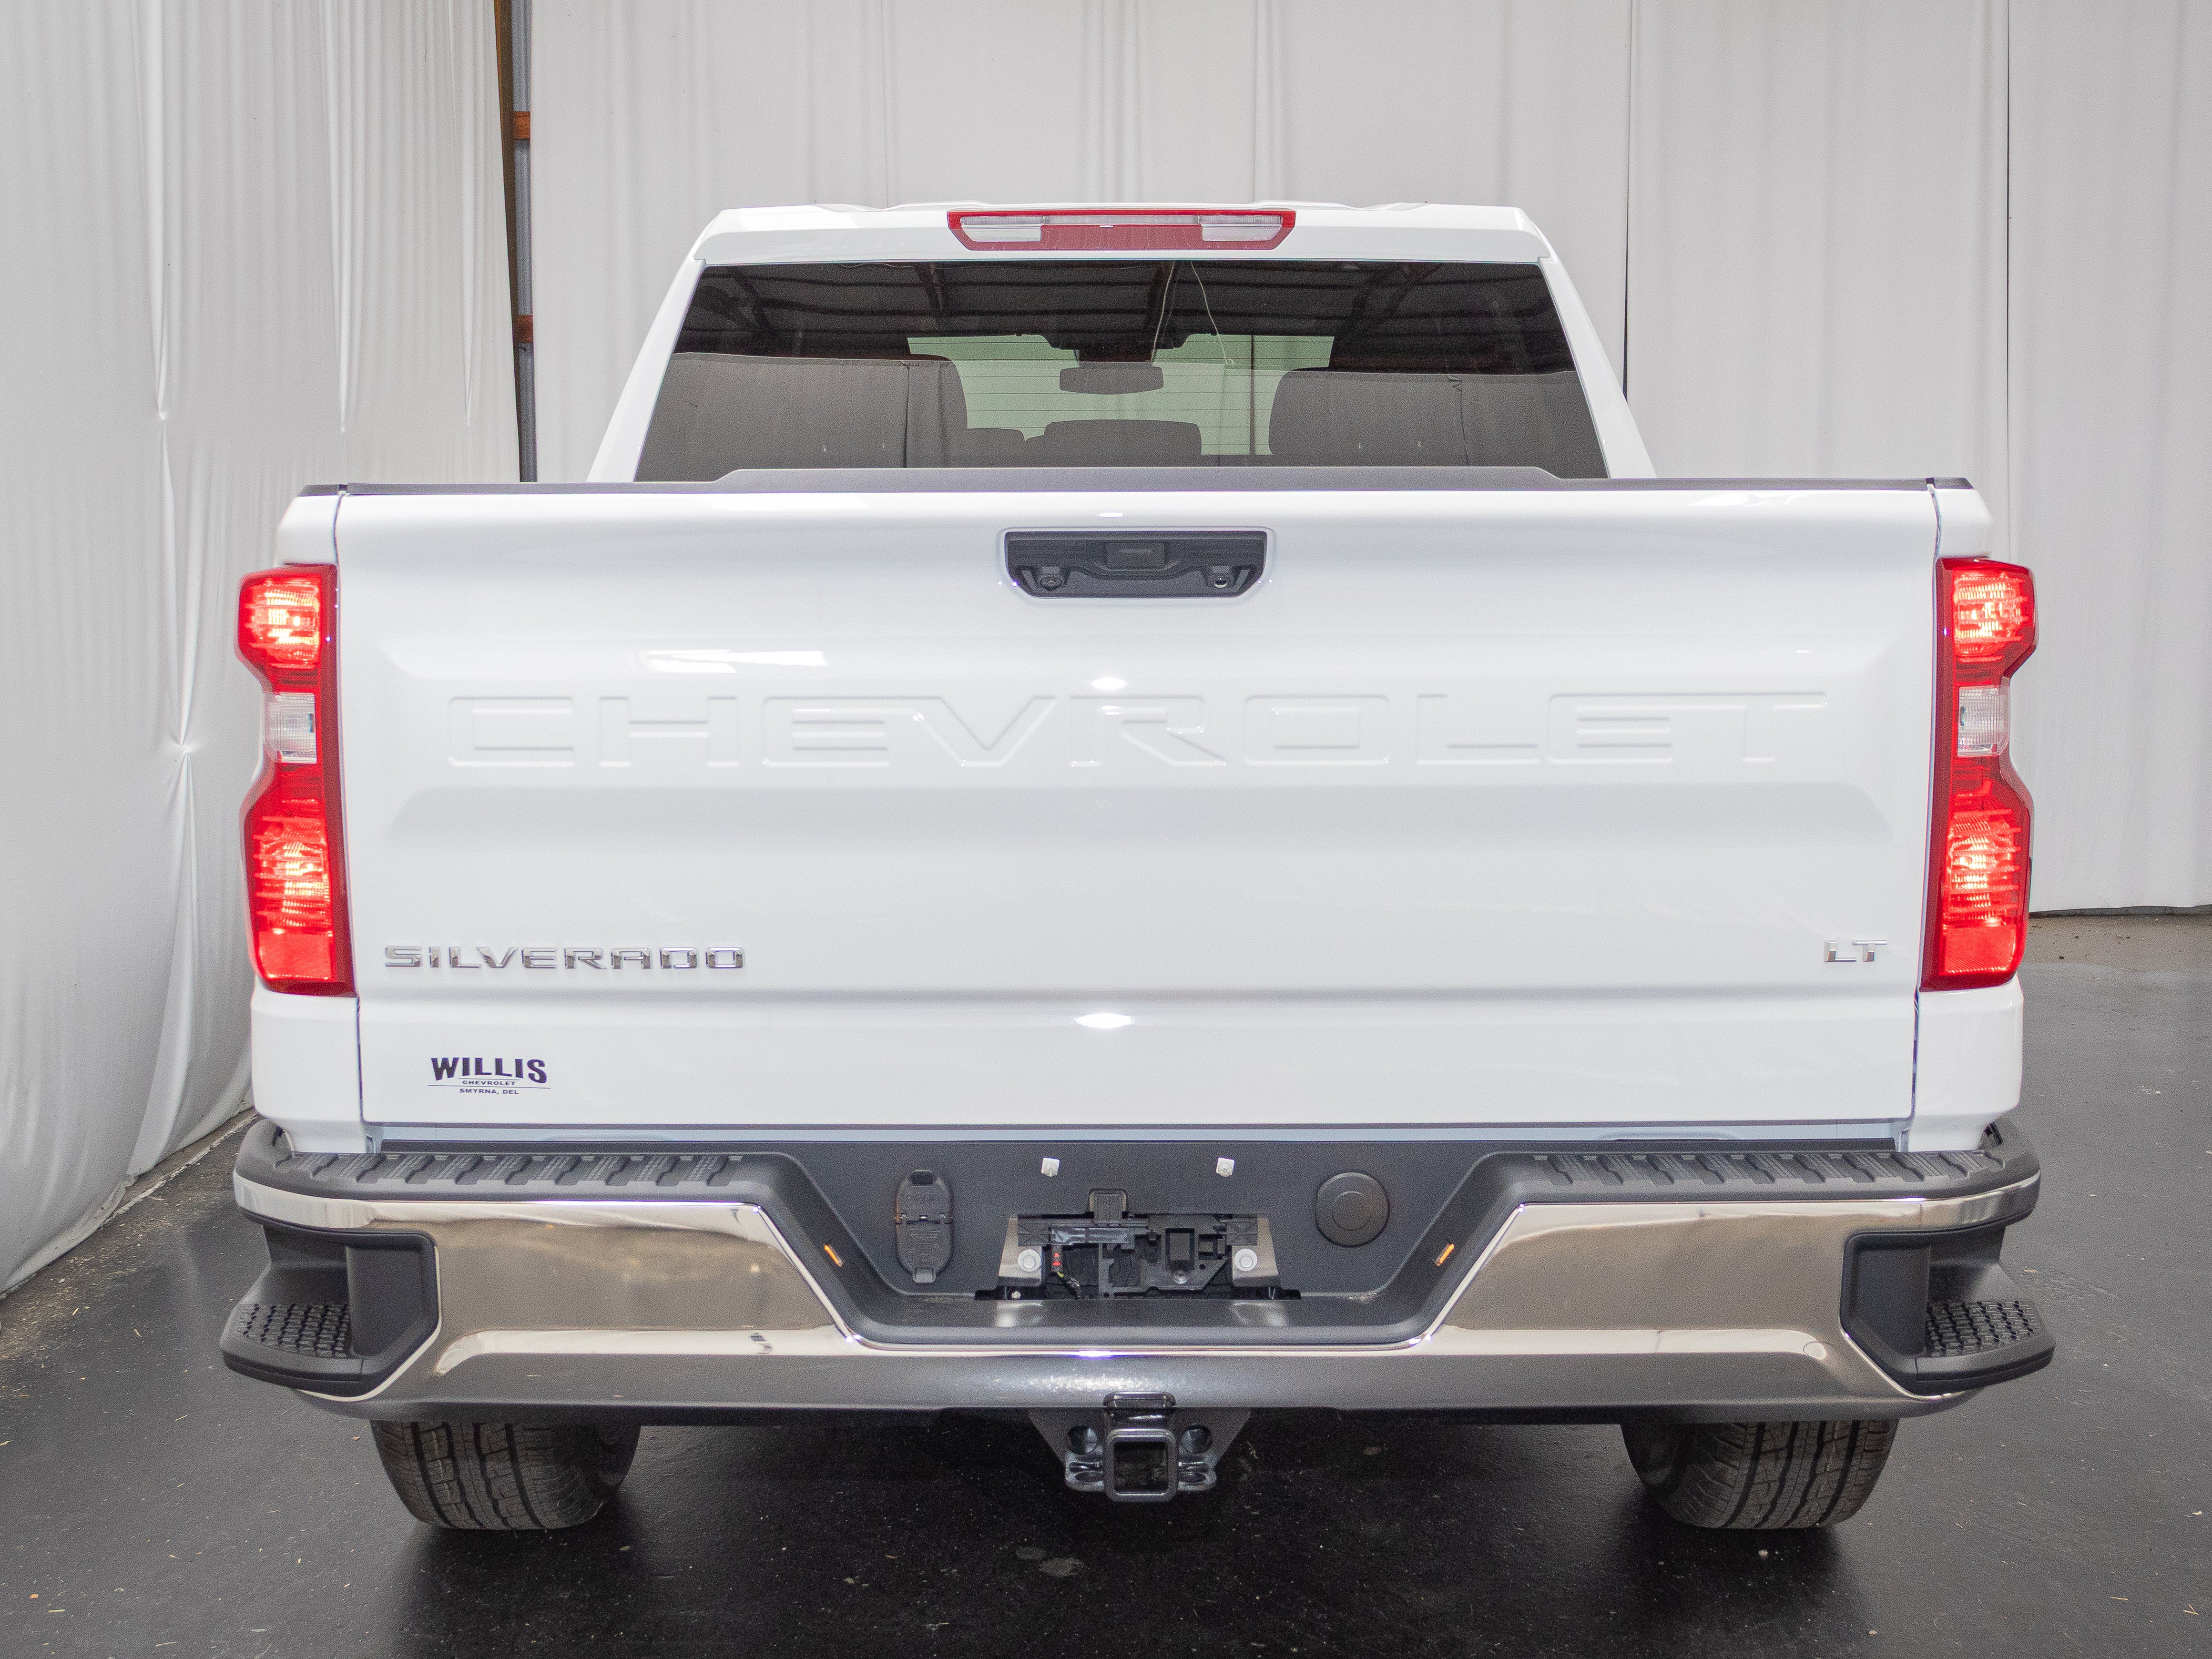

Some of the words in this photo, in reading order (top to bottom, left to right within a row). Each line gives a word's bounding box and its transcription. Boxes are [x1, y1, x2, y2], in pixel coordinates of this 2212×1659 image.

[448, 692, 1827, 770] CHEVROLET
[385, 945, 745, 970] SILVERADO
[1824, 940, 1888, 962] LT
[431, 1057, 547, 1084] WILLIS
